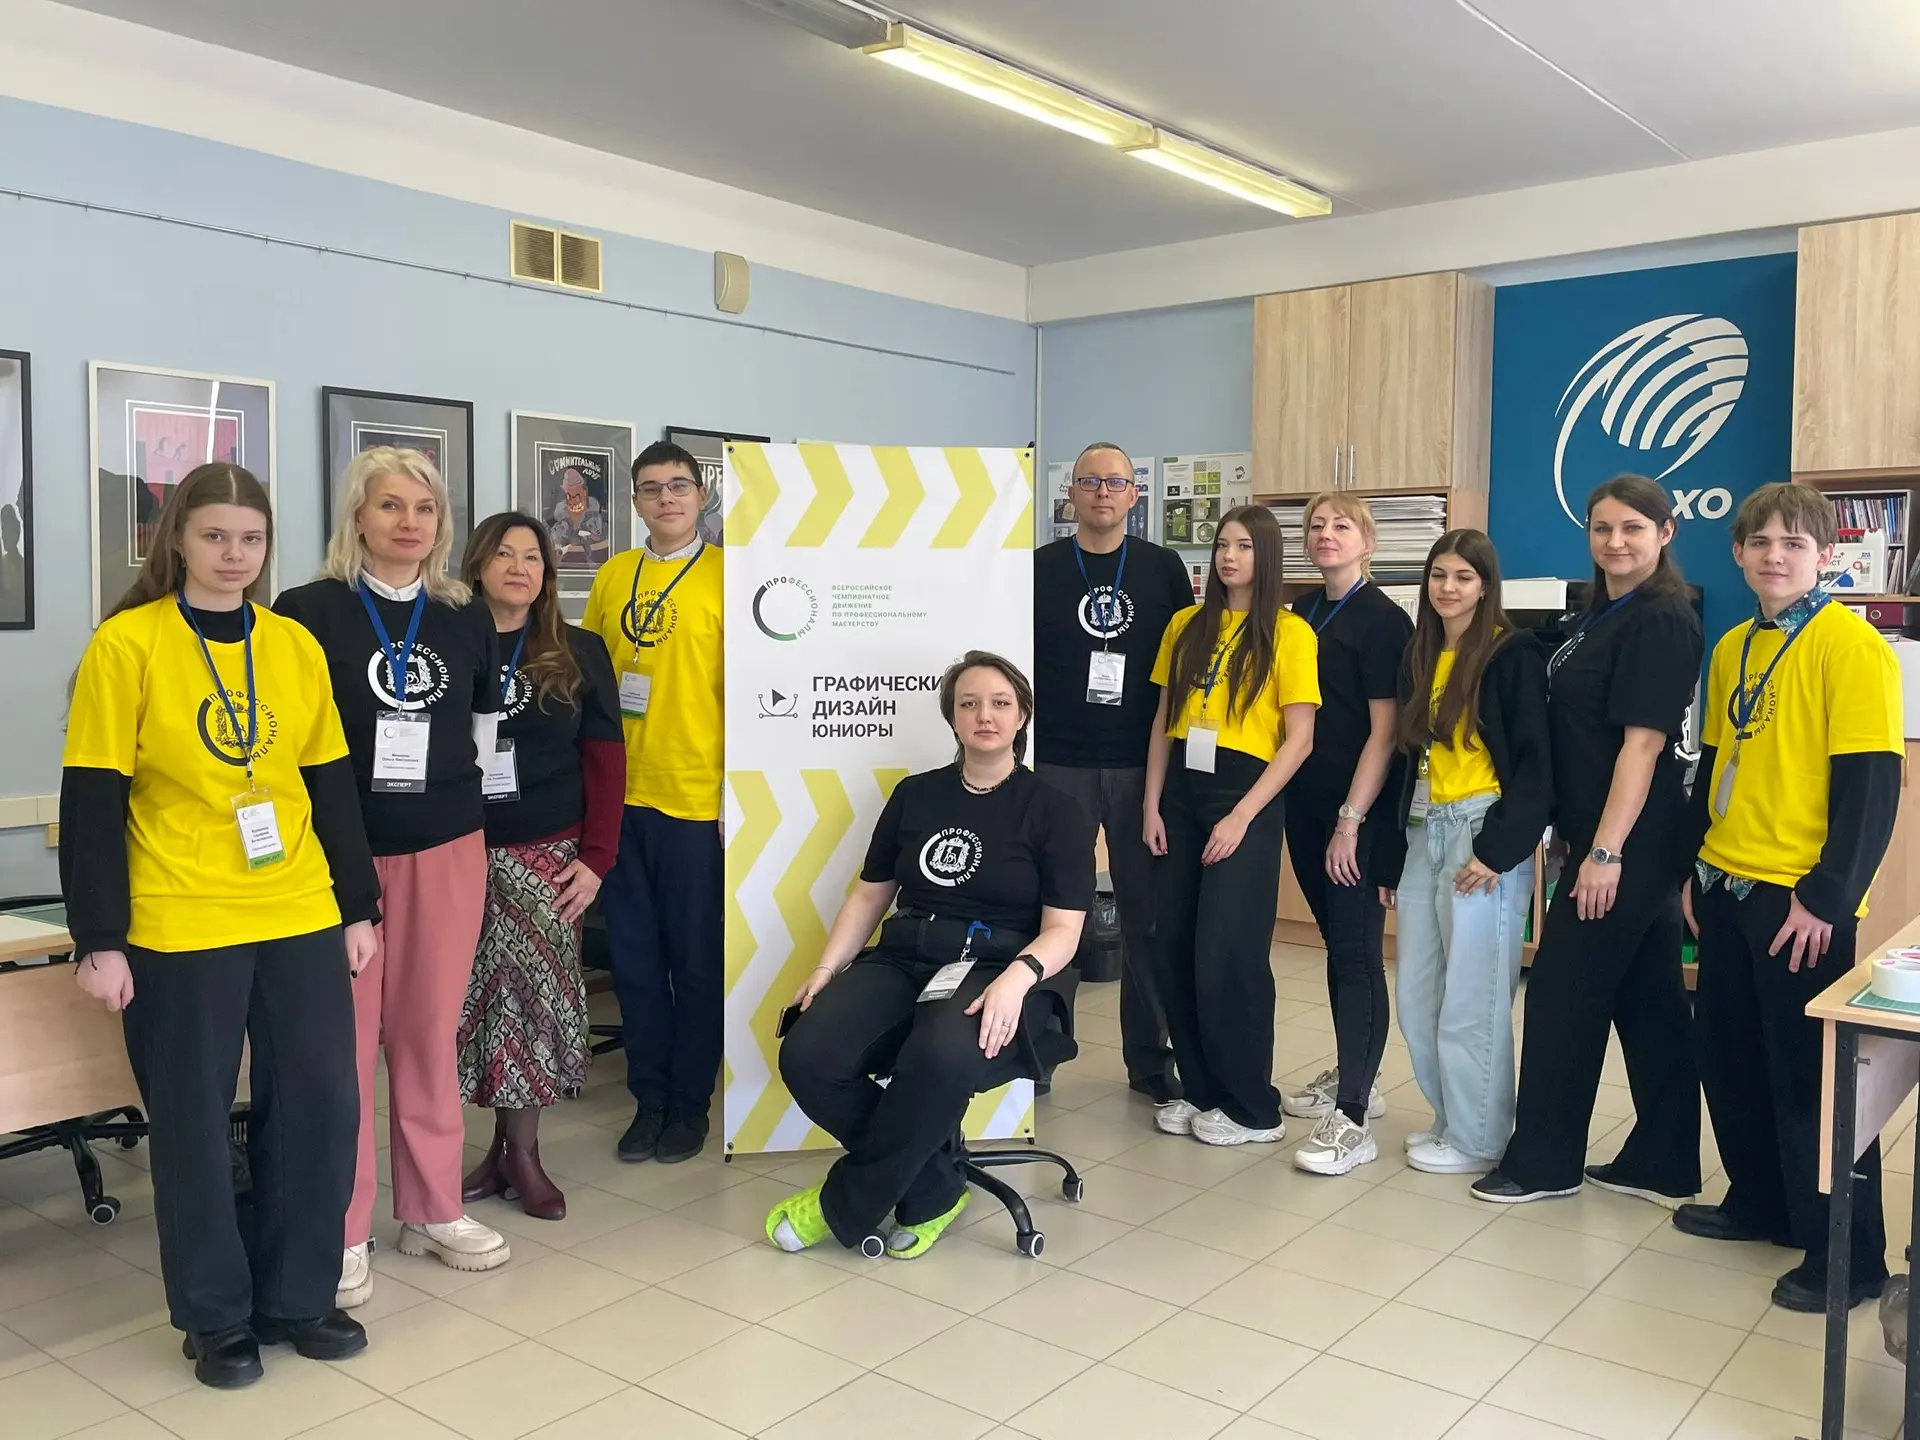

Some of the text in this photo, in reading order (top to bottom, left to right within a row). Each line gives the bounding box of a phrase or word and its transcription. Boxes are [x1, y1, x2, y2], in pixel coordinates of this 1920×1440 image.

[637, 589, 678, 646] ПРОФССИОНАЛЫ
[765, 576, 818, 638] ПРОФЕССИОНАЛЫ
[1088, 585, 1135, 635] РОФССИОНАЛЫ
[812, 676, 944, 692] ГРАФИЧЕСКИ
[812, 696, 896, 720] ДИЗАЙН
[812, 723, 893, 738] ЮНИОРЫ
[941, 827, 983, 886] ПРОФЕССИОНАЛЫ
